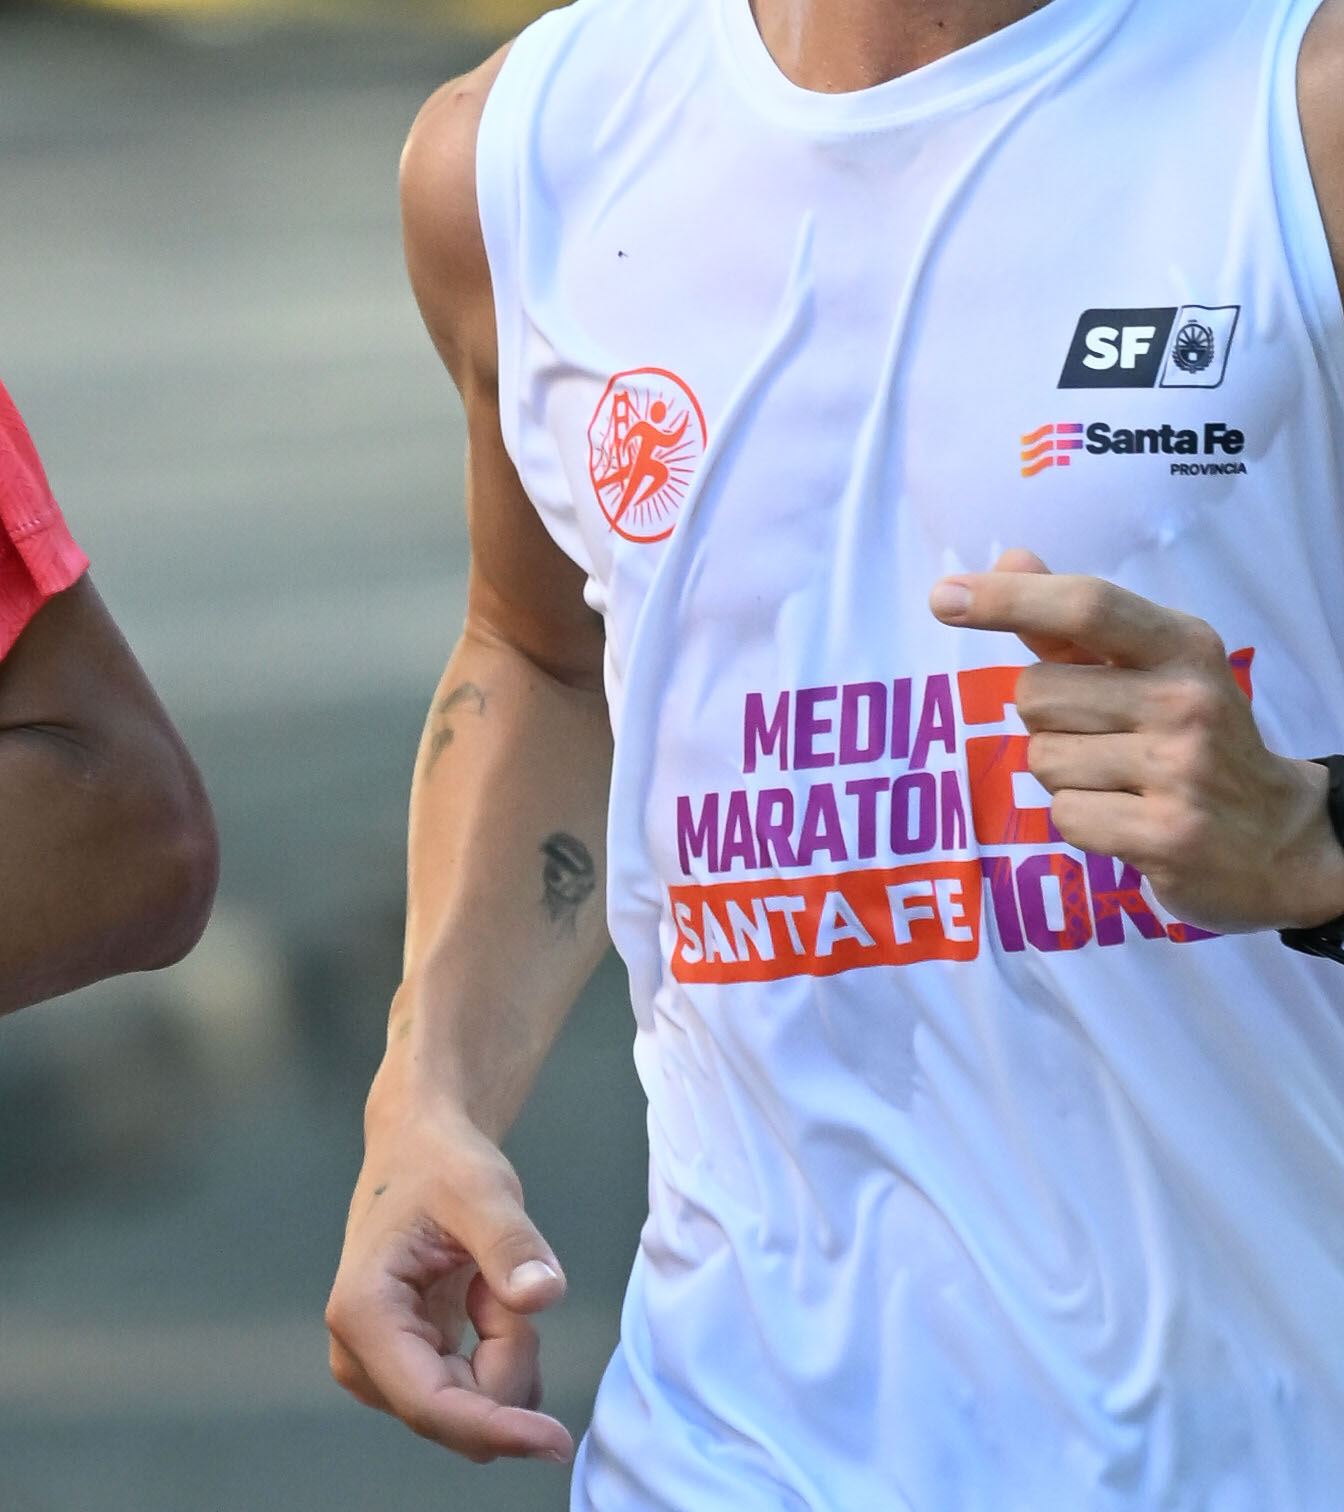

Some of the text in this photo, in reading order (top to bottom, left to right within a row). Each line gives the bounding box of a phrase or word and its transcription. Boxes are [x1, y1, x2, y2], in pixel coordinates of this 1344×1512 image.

[1082, 326, 1156, 370] SF
[1086, 422, 1245, 455] Santa Fe
[1170, 462, 1247, 476] PROVINCIA
[743, 673, 957, 773] MEDIA
[675, 879, 974, 963] SANTA FE
[980, 852, 1224, 952] 10K
